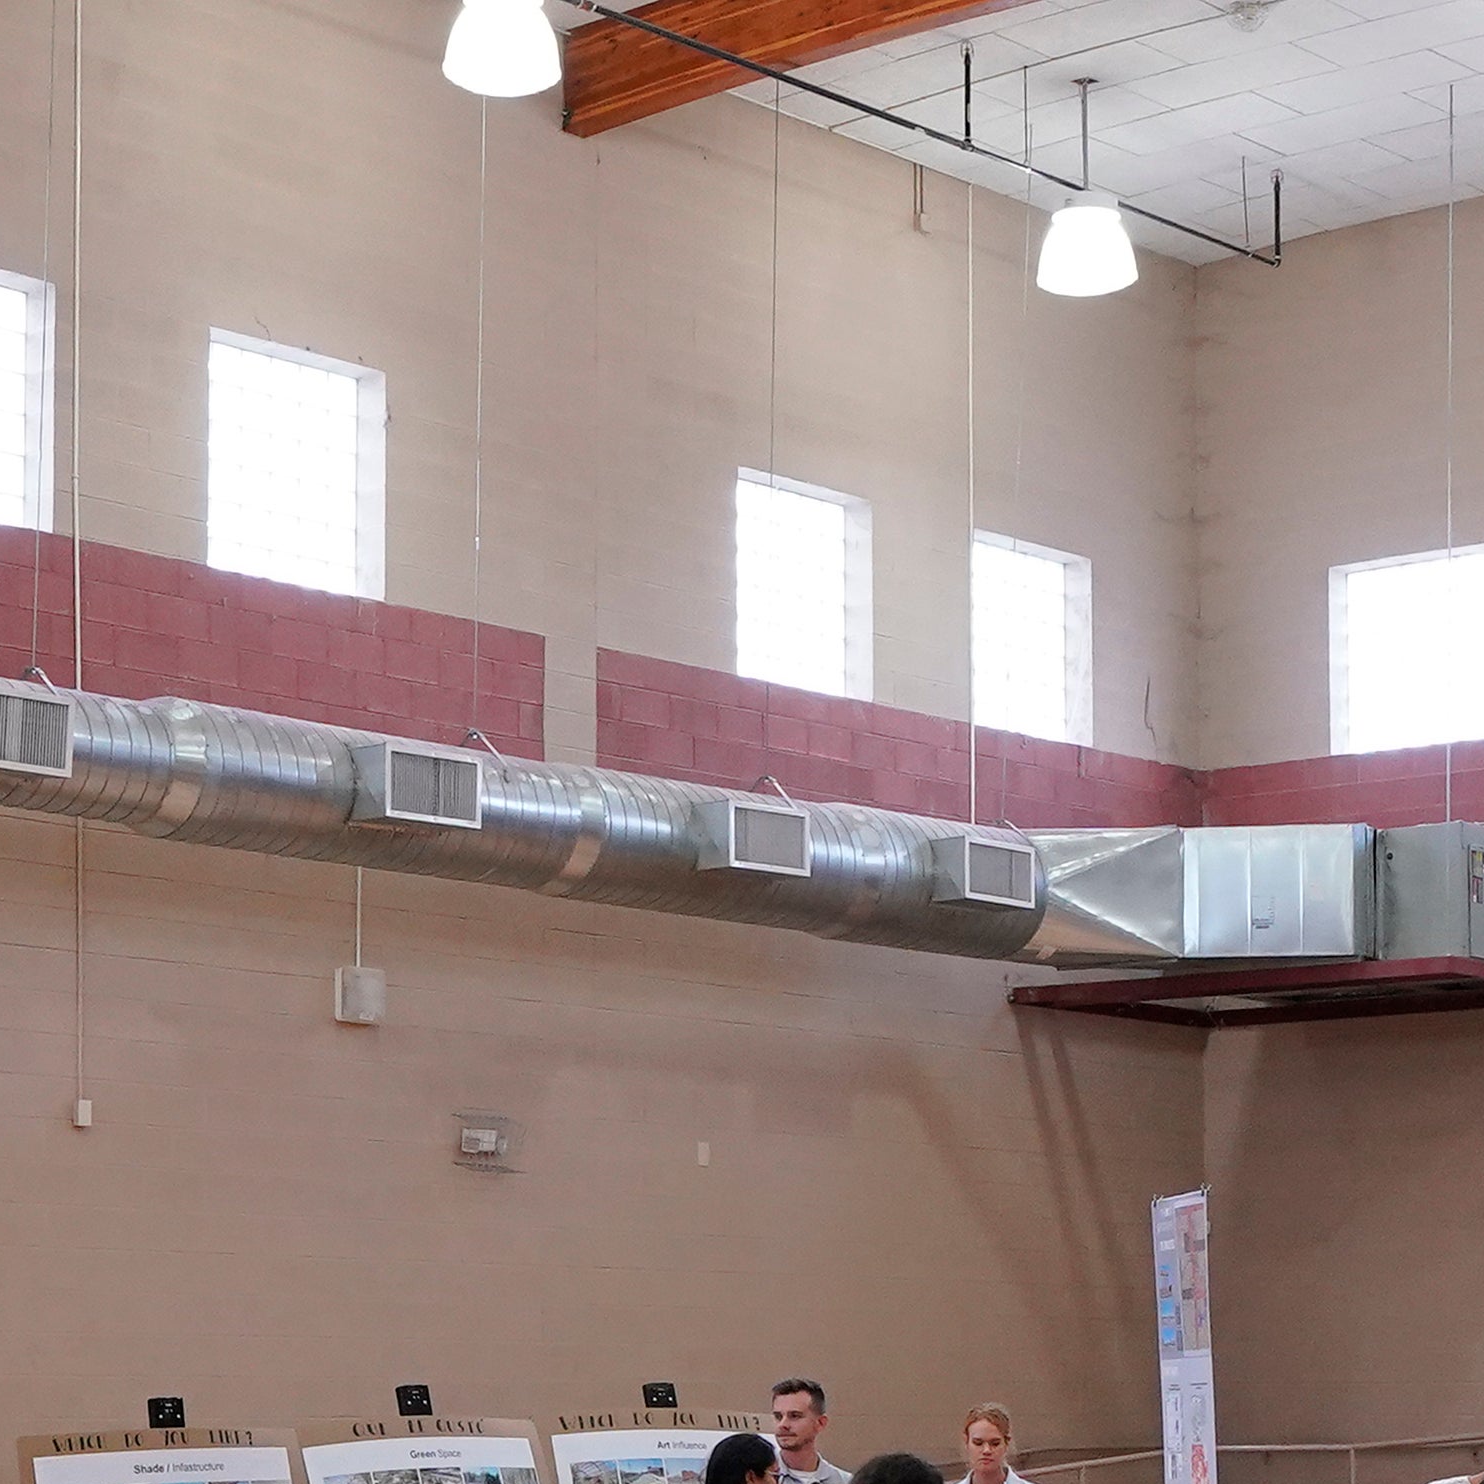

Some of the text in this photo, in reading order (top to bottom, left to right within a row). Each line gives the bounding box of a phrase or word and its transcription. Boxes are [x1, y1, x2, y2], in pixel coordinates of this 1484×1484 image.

[657, 1440, 707, 1450] Art Influence
[410, 1449, 462, 1460] Green Space
[133, 1463, 165, 1474] Shade
